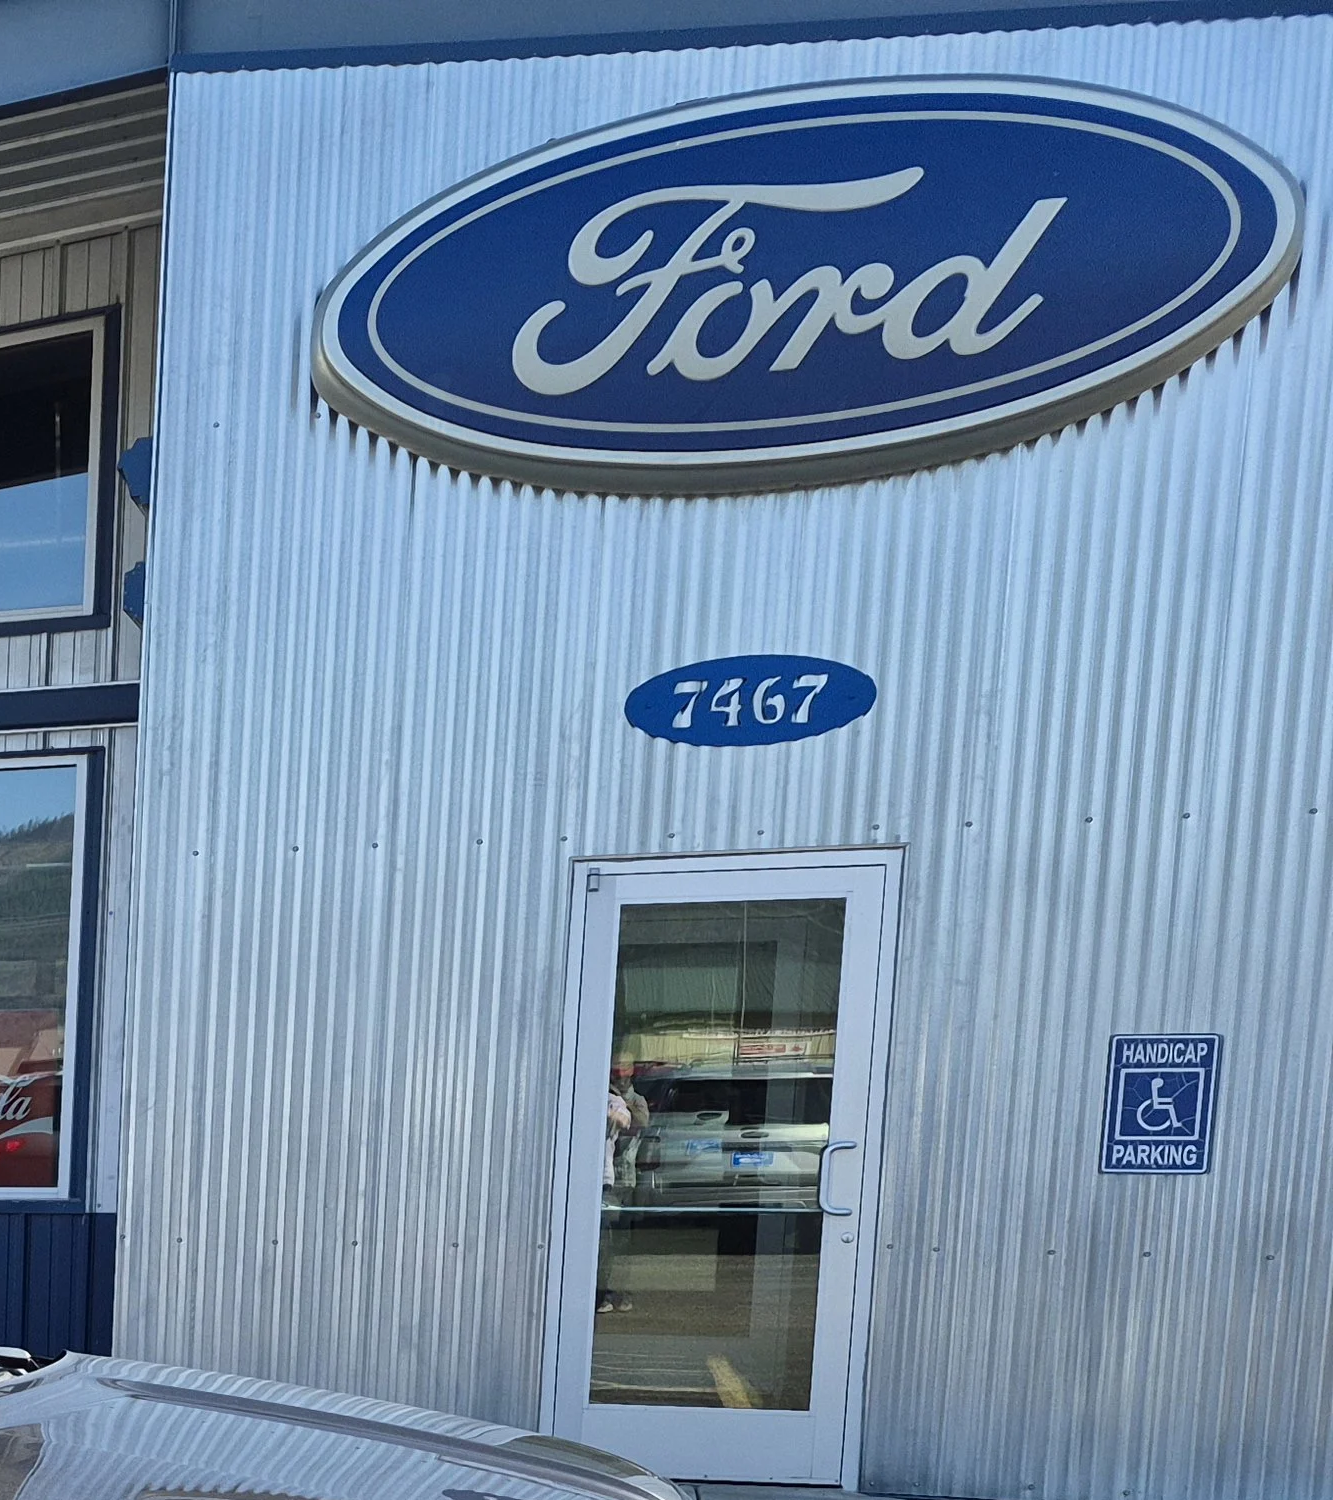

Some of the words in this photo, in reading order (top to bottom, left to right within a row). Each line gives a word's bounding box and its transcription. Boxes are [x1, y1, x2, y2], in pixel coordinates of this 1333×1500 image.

[512, 166, 1068, 395] Ford
[670, 672, 829, 730] 7467
[1122, 1042, 1208, 1064] HANDICAP
[1111, 1144, 1197, 1167] PARKING
